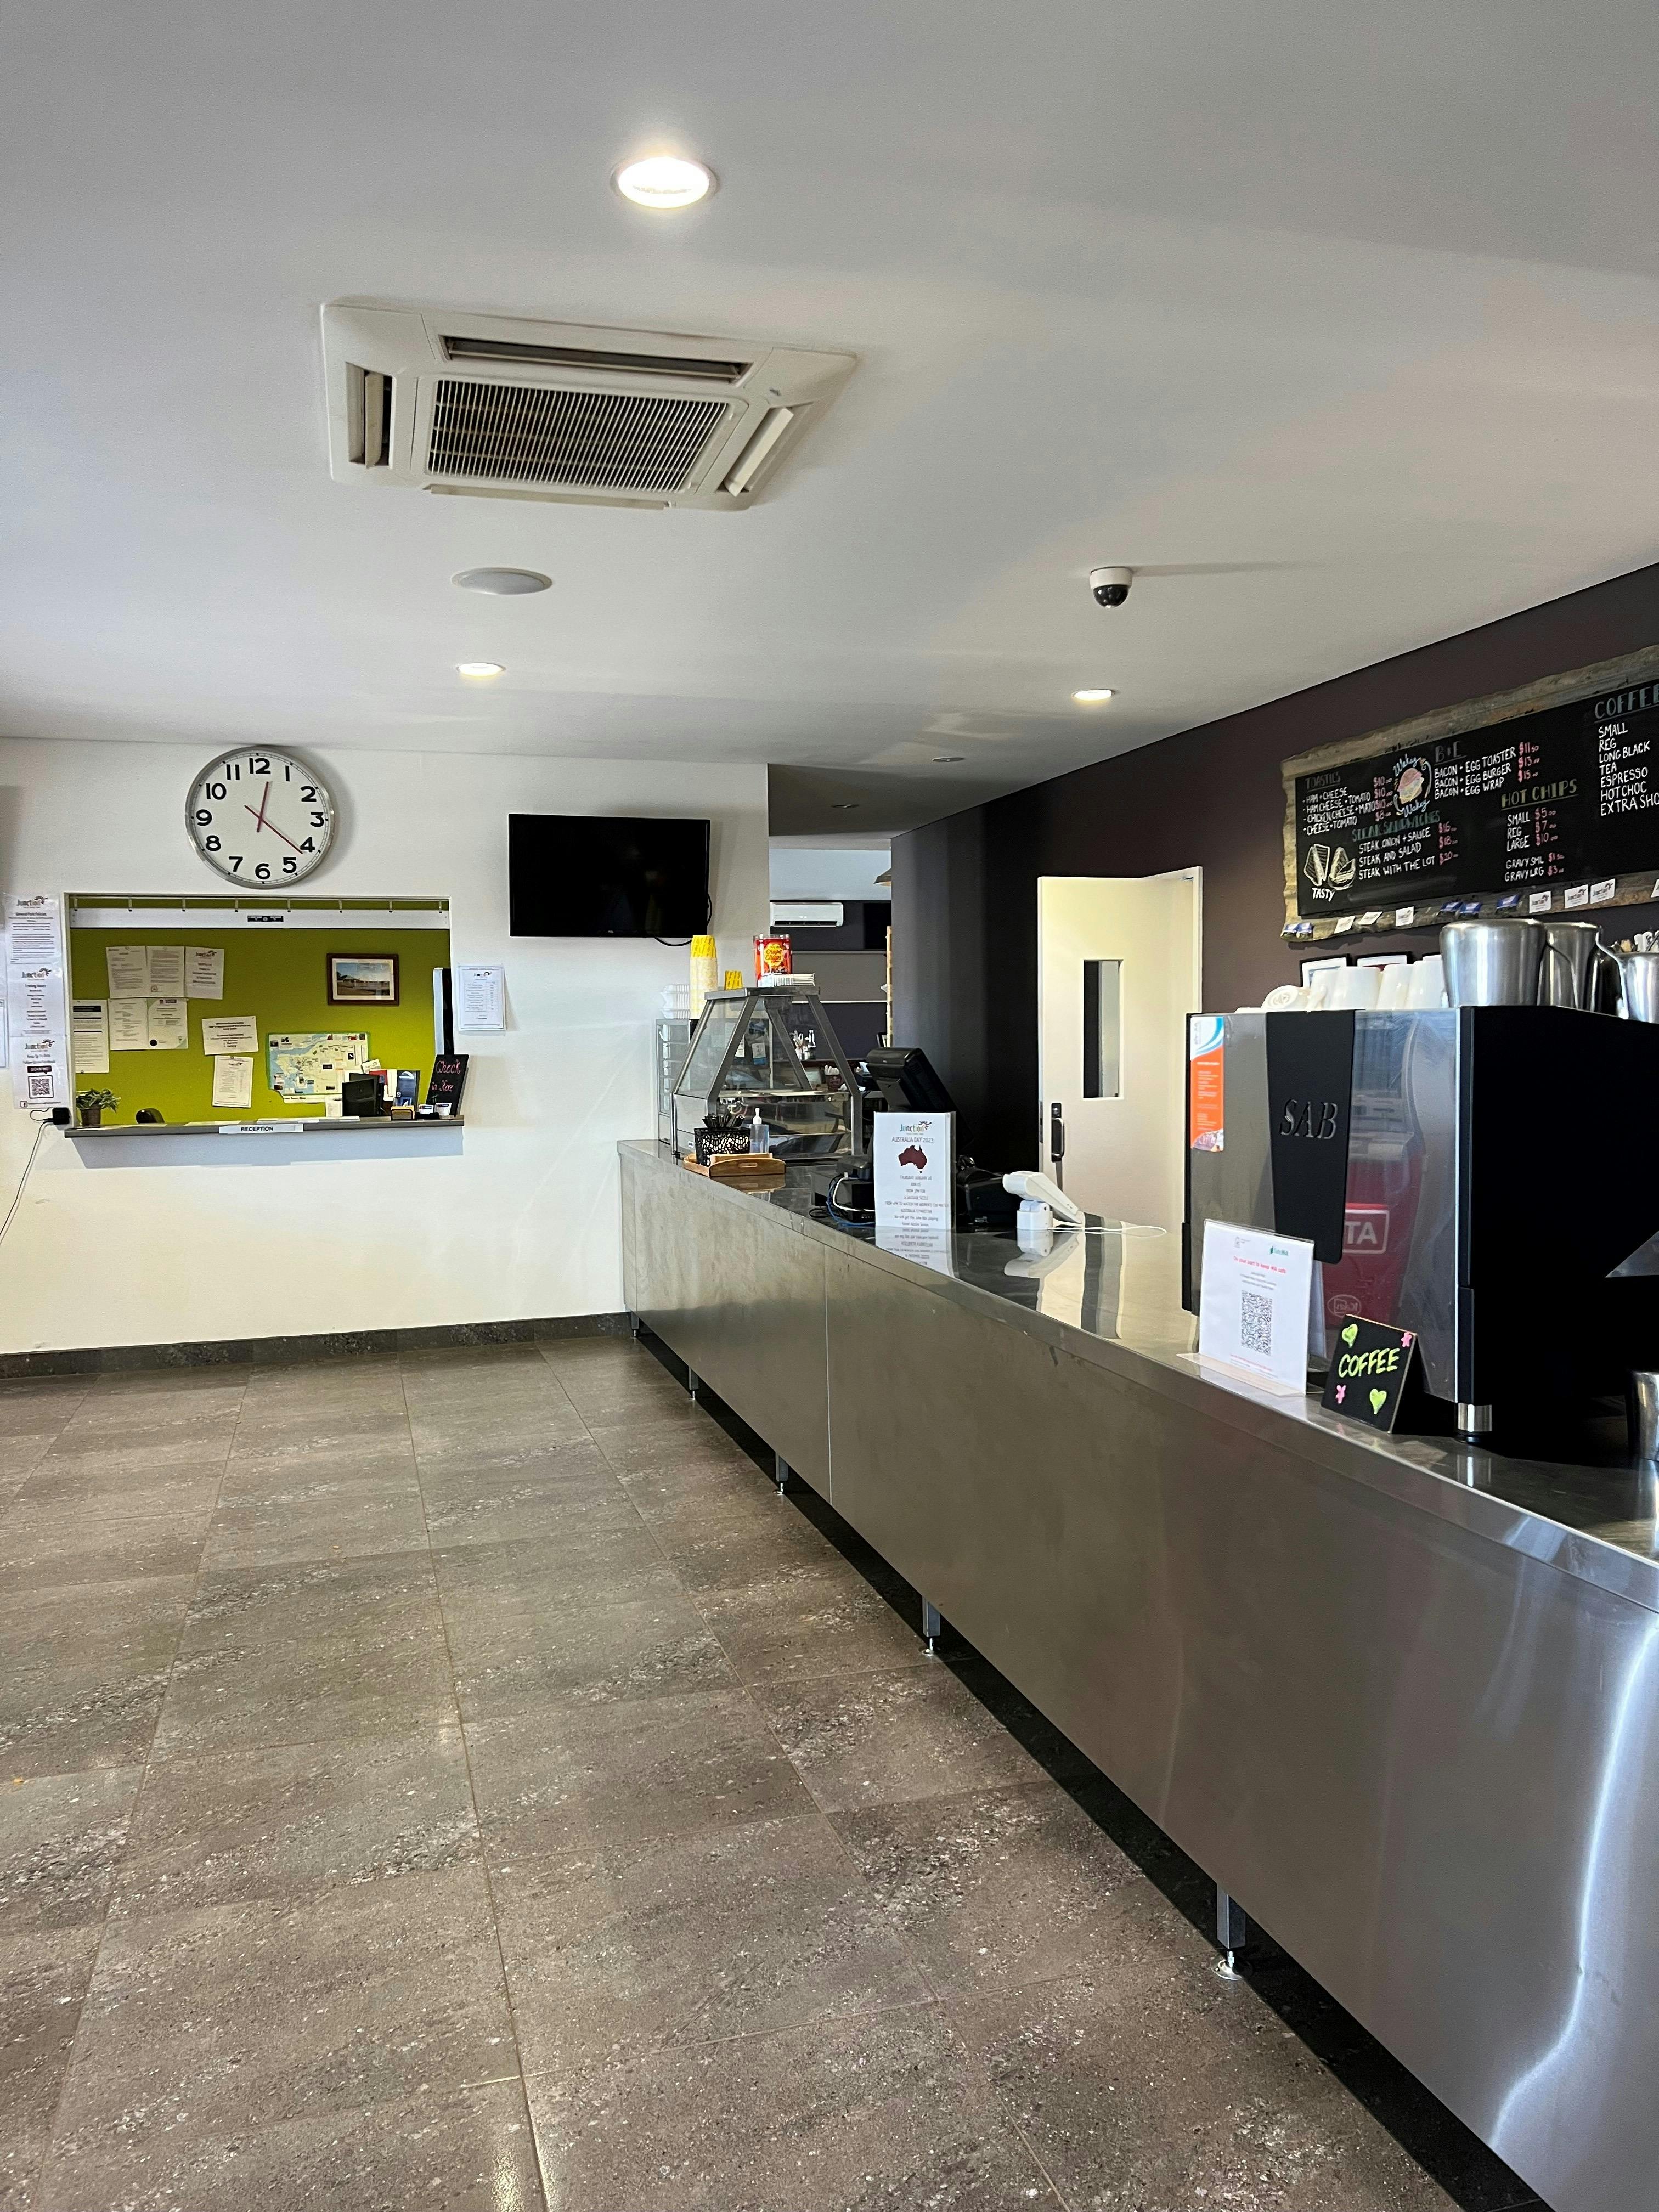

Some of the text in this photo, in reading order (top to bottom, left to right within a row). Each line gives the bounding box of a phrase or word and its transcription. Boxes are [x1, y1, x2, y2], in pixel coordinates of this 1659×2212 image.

[1598, 722, 1628, 738] SMALL
[1599, 737, 1616, 752] REG
[1599, 740, 1650, 763] LONG BLACK
[249, 758, 271, 775] 12
[1435, 764, 1457, 778] BACON
[1465, 760, 1480, 772] EGG
[1482, 747, 1516, 767] TOASTER
[1599, 761, 1617, 776] TEA
[226, 764, 240, 780] 11
[285, 766, 290, 782] 1
[1435, 776, 1458, 788] BACON
[1465, 774, 1481, 785] EGG
[1483, 763, 1512, 780] BURGER
[1601, 766, 1648, 788] ESPRESSO
[206, 782, 227, 800] 10
[300, 786, 317, 802] 2
[1435, 786, 1459, 799] BACON
[1465, 785, 1480, 795] EGG
[1483, 777, 1504, 791] WRAP
[1502, 779, 1577, 808] HOT CHIPS
[1601, 781, 1647, 802] HOT CHOC
[1601, 797, 1638, 816] EXTRA
[195, 809, 212, 826] 9
[310, 811, 325, 827] 3
[1507, 811, 1531, 827] SMALL
[1359, 840, 1380, 854] STEAK
[1407, 827, 1431, 842] SAUCE
[1507, 826, 1522, 839] REG
[205, 835, 221, 851] 8
[300, 836, 315, 853] 4
[1506, 834, 1530, 852] LARGE
[1359, 853, 1381, 867] STEAK
[1383, 851, 1396, 862] AND
[1398, 842, 1421, 858] SALAD
[1505, 857, 1530, 869] GRAVY
[228, 856, 243, 872] 7
[255, 863, 270, 880] 6
[282, 857, 297, 873] 5
[1359, 867, 1381, 880] STEAK
[1383, 864, 1402, 875] WITH
[1403, 859, 1420, 871] THE
[1422, 856, 1435, 867] LOT
[1504, 870, 1529, 882] GRAVY
[1530, 866, 1544, 877] LRG
[1312, 888, 1335, 902] TASTY
[436, 1059, 461, 1074] Check
[431, 1081, 437, 1090] in
[1279, 1098, 1338, 1139] SAB
[900, 1124, 924, 1132] Junction
[1338, 1348, 1400, 1378] COFFEE
